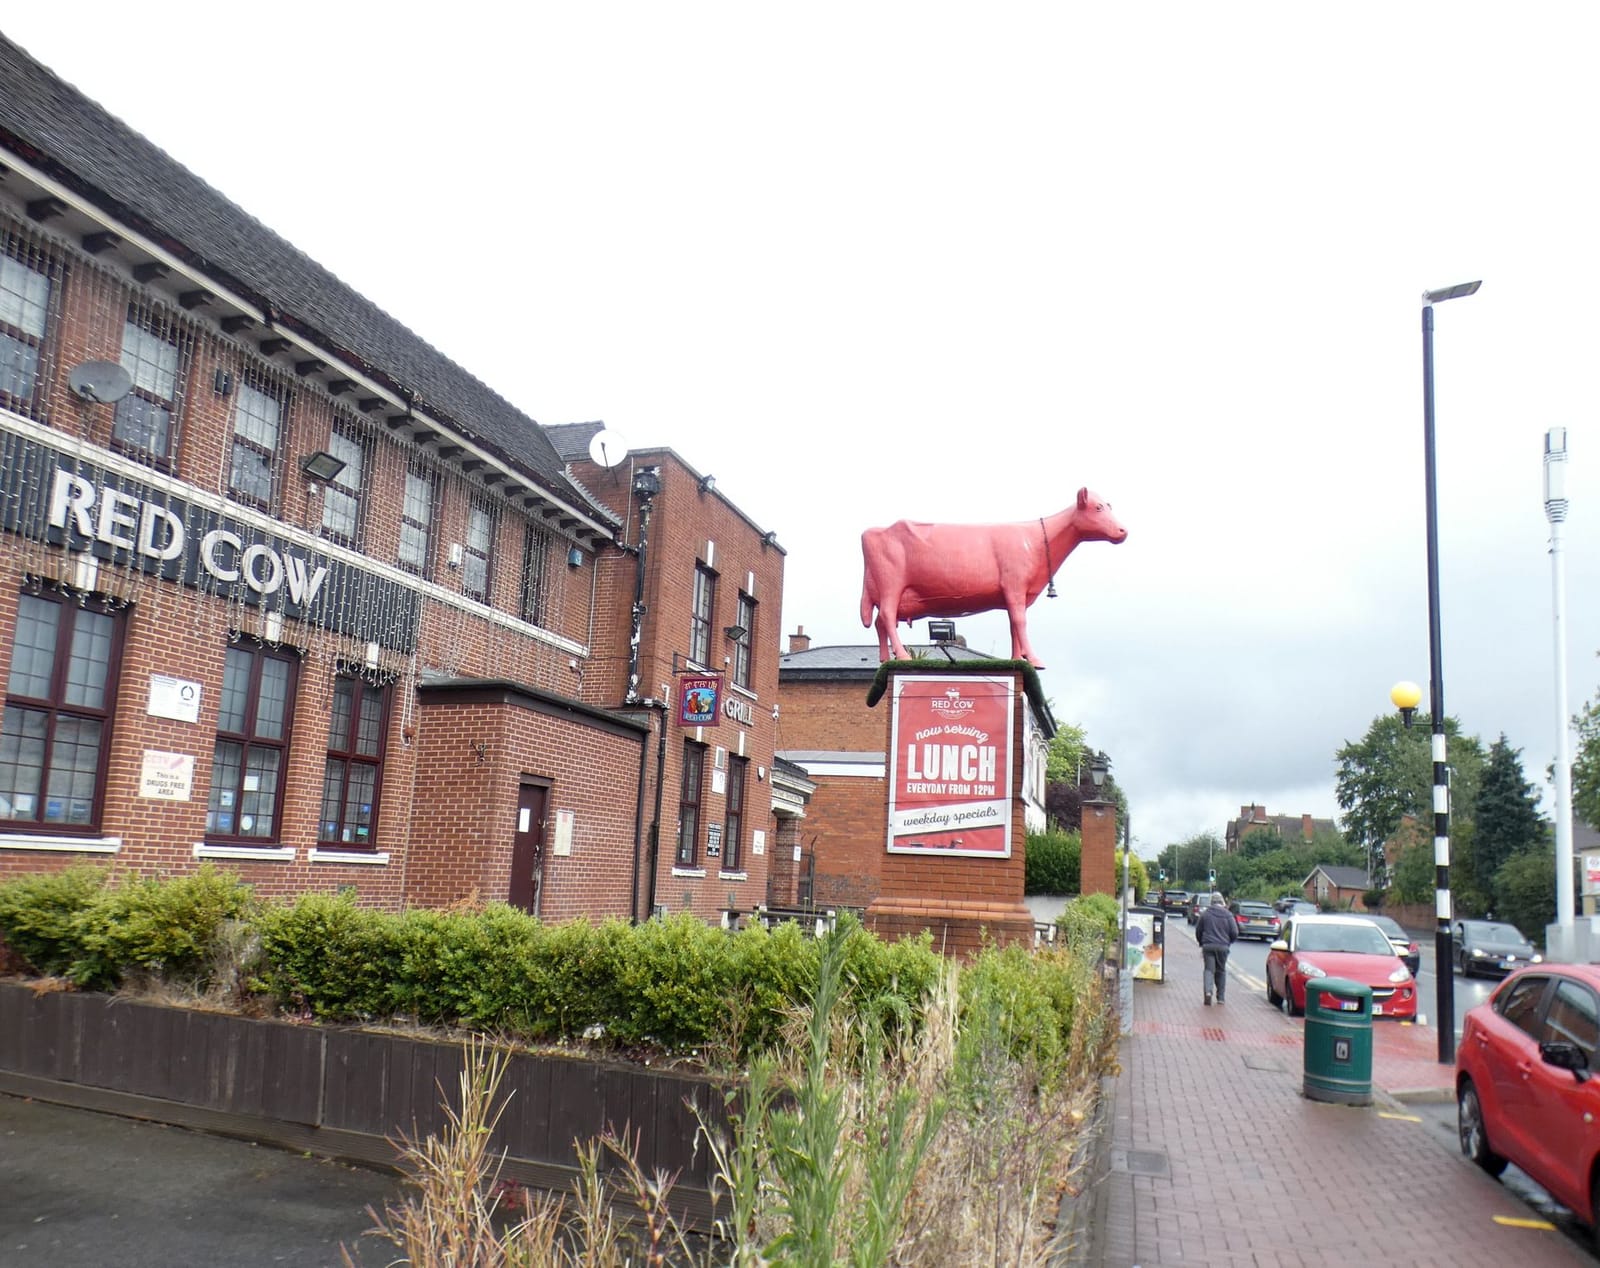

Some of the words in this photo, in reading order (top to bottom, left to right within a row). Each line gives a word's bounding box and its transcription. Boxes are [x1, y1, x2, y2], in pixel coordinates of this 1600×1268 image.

[50, 468, 184, 560] RED
[201, 529, 327, 607] COW
[725, 697, 754, 726] GRILL
[931, 700, 951, 709] RED
[953, 700, 974, 709] COW
[915, 726, 943, 741] now
[944, 724, 989, 744] serving
[907, 743, 996, 782] LUNCH
[156, 771, 169, 779] This
[146, 779, 168, 788] DRUGS
[169, 781, 185, 790] FREE
[158, 788, 174, 796] AREA
[906, 782, 946, 794] EVERYDAY
[948, 783, 971, 795] FROM
[973, 784, 995, 796] 12PM
[903, 811, 950, 826] weekday
[952, 806, 998, 824] specials
